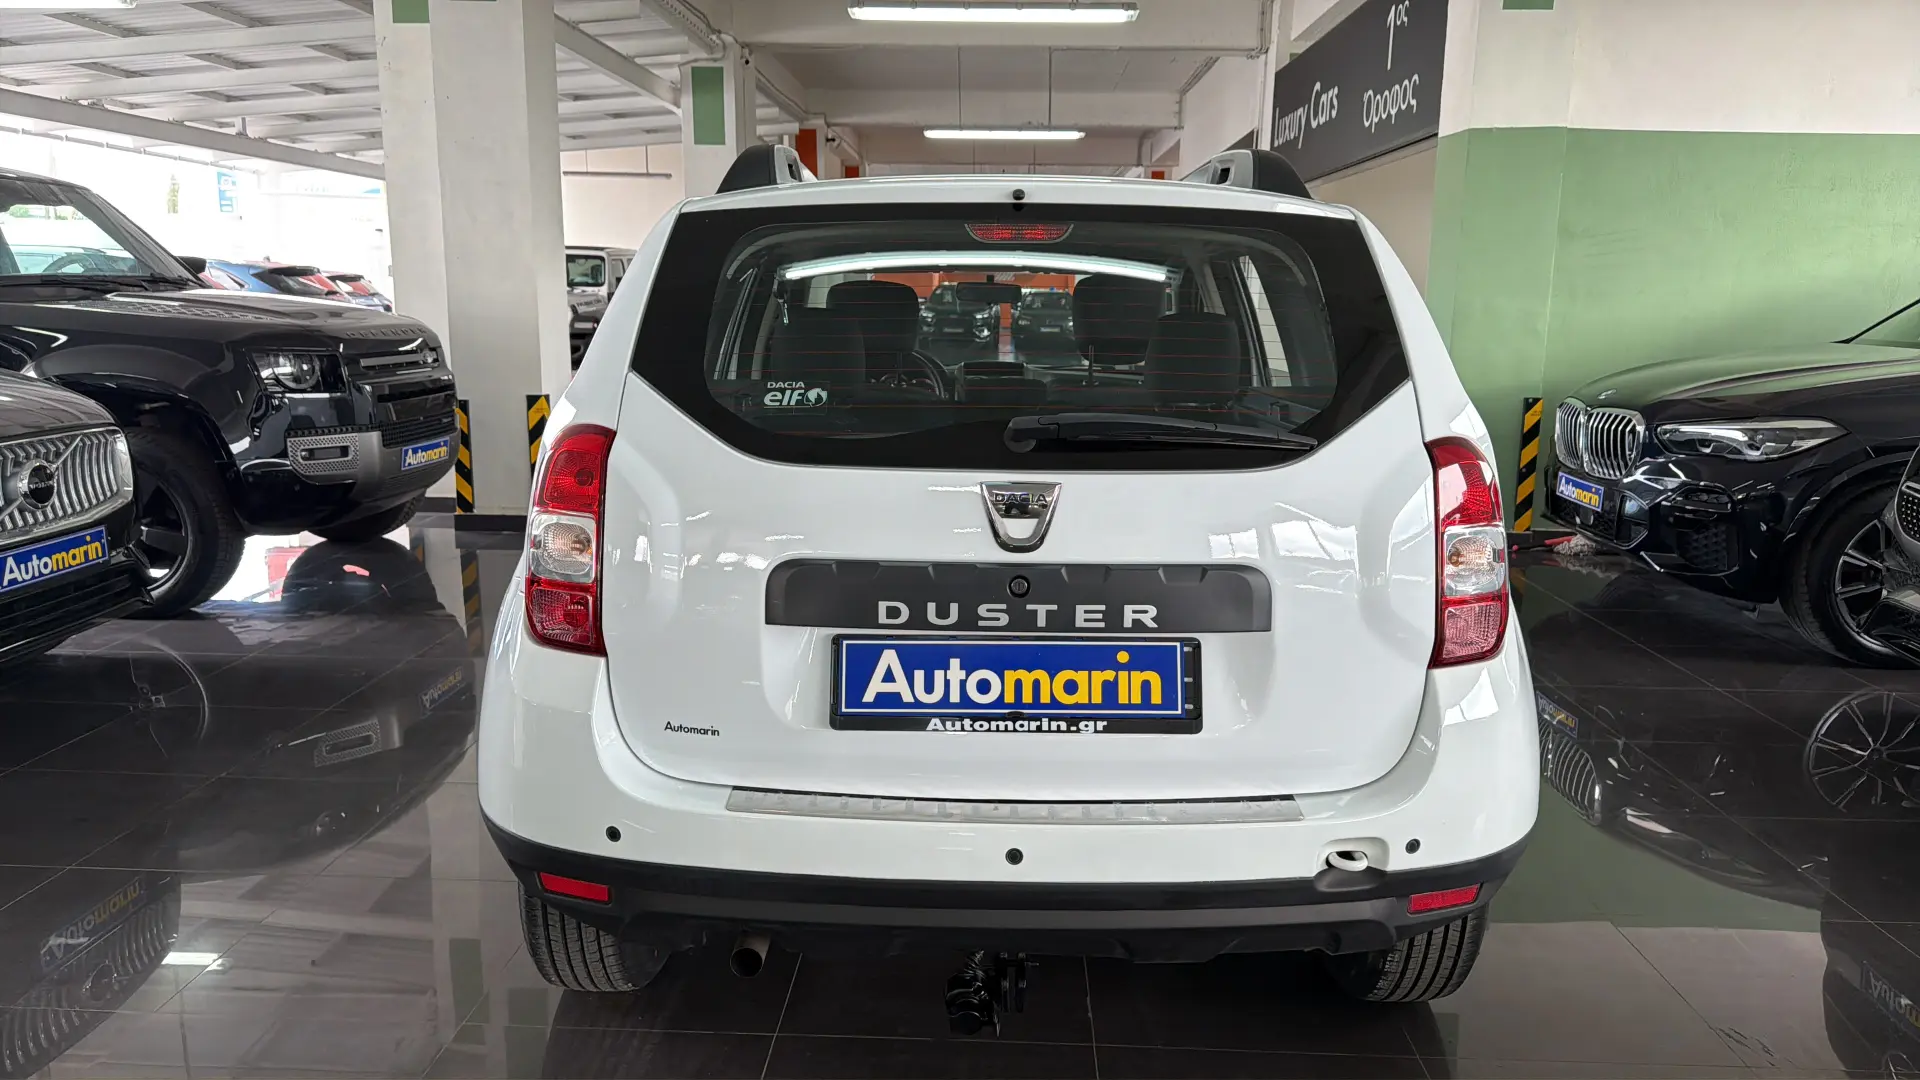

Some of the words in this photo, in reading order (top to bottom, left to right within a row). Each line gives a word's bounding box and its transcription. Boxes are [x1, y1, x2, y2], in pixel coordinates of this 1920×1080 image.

[1274, 104, 1308, 149] Luxury
[1310, 81, 1339, 129] Cars
[763, 389, 805, 406] elf
[767, 381, 805, 389] DACIA
[405, 441, 448, 467] Automarin
[993, 492, 1048, 504] DACIA
[1559, 476, 1599, 508] Automarin
[2, 535, 103, 587] Automarin
[877, 600, 1159, 628] DUSTER
[861, 648, 1162, 706] Automarin
[664, 720, 720, 737] Automarin
[926, 717, 1108, 734] Automarin.gr
